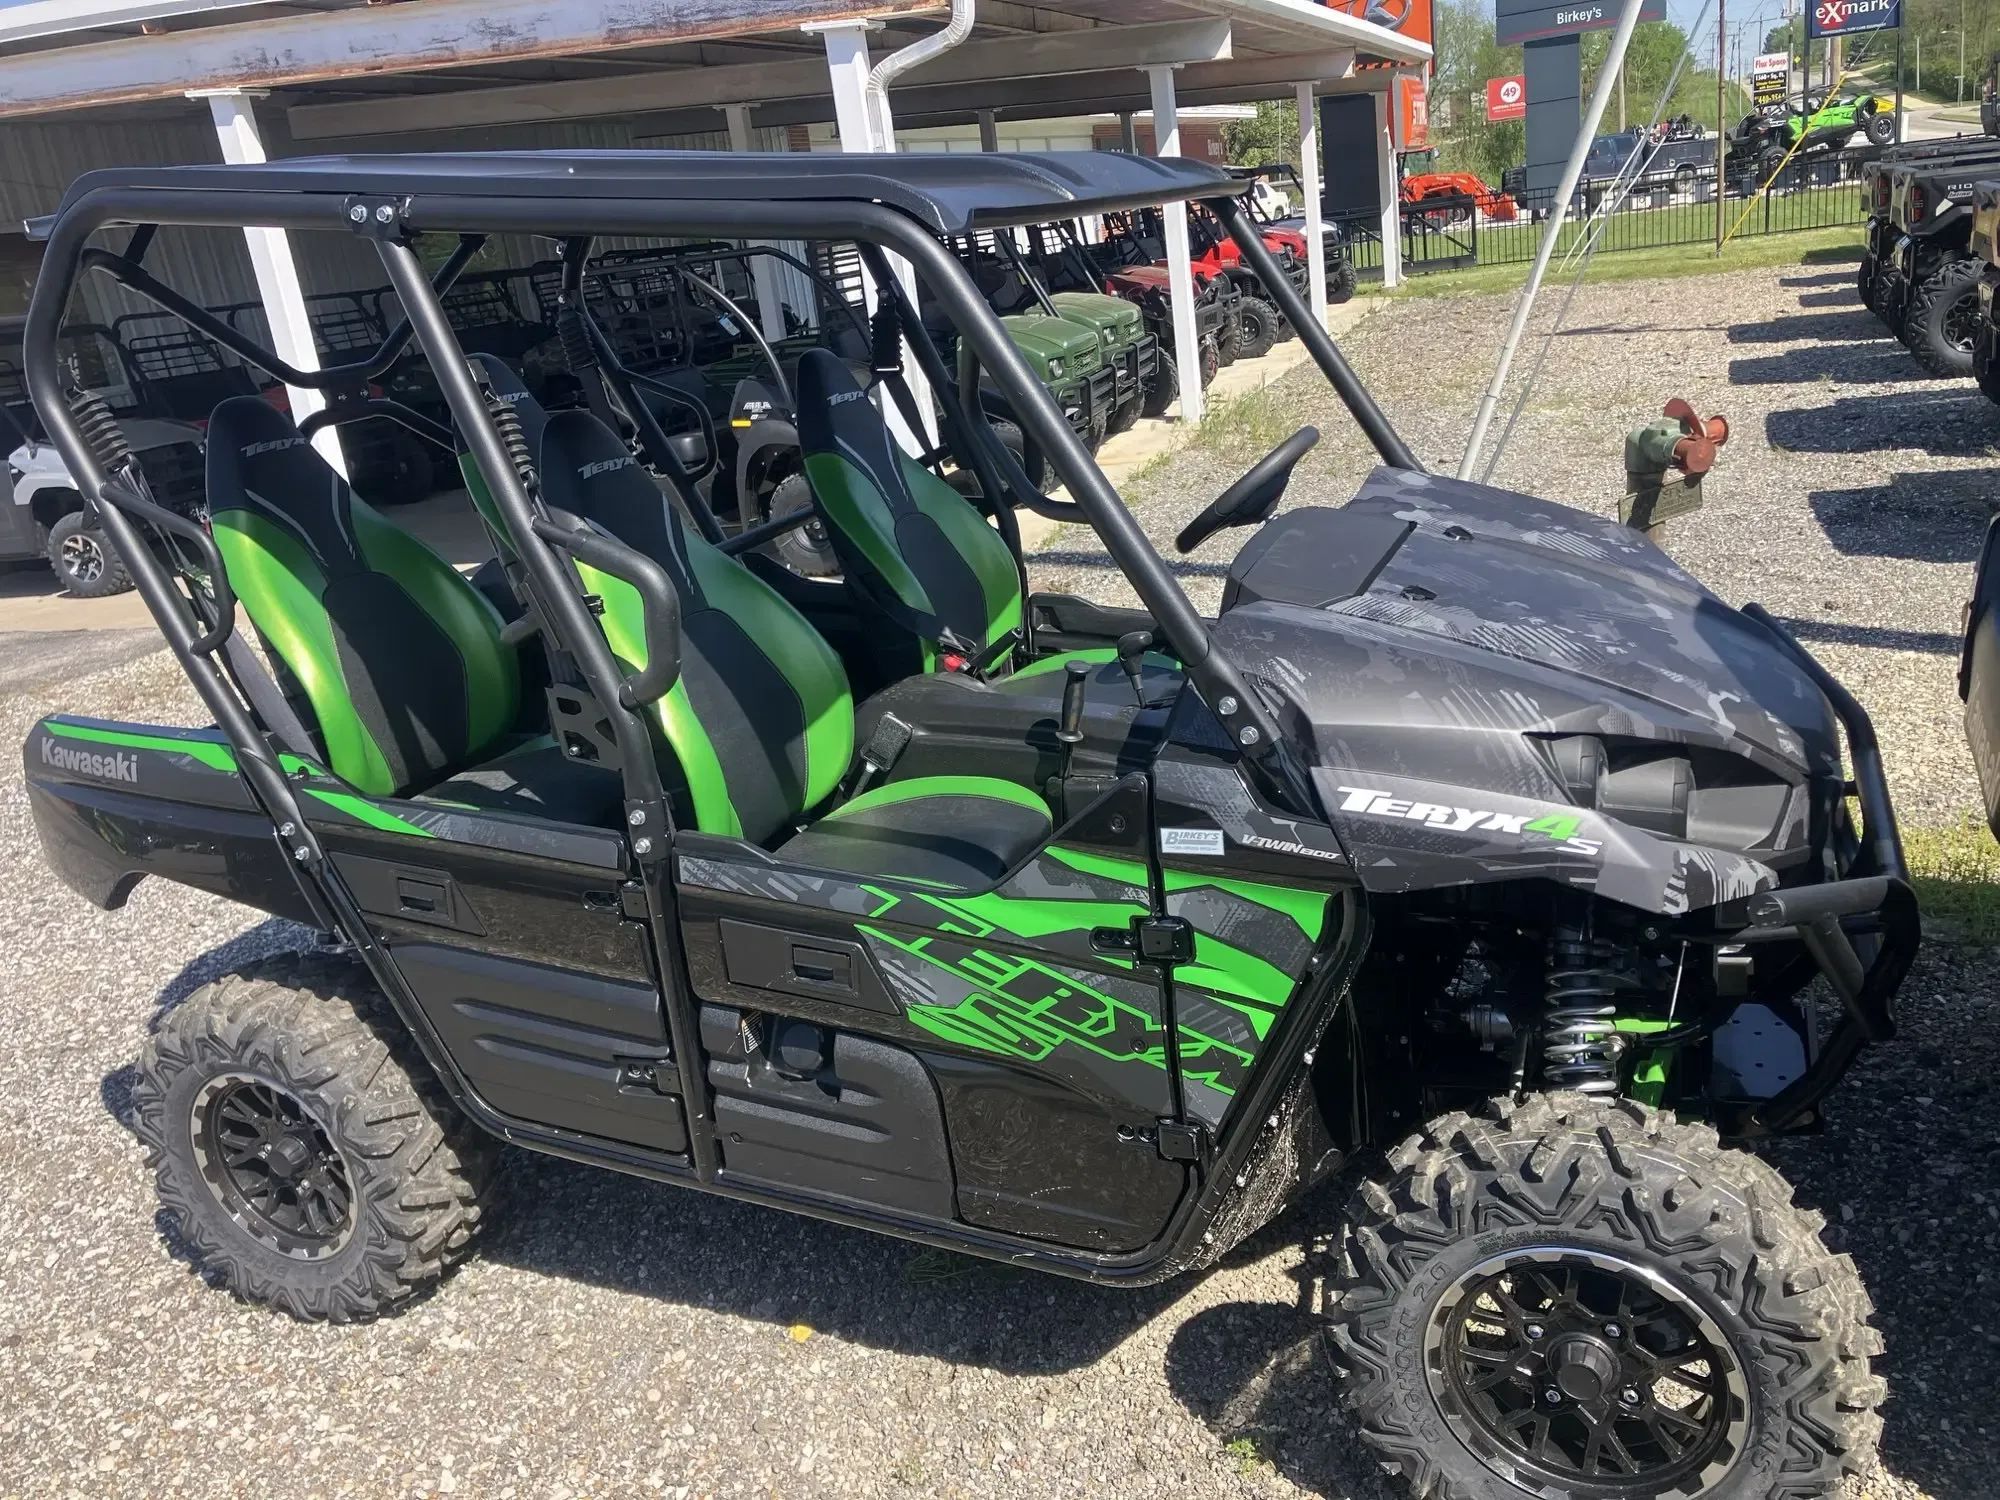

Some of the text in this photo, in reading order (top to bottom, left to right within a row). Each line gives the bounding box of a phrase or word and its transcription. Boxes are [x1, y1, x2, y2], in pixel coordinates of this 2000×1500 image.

[1556, 8, 1602, 25] Birkey's
[1502, 86, 1517, 98] 49
[240, 437, 306, 457] TERYX
[577, 456, 635, 480] TERYX
[41, 736, 138, 784] Kawasaki
[1164, 831, 1220, 846] BIRKEY'S
